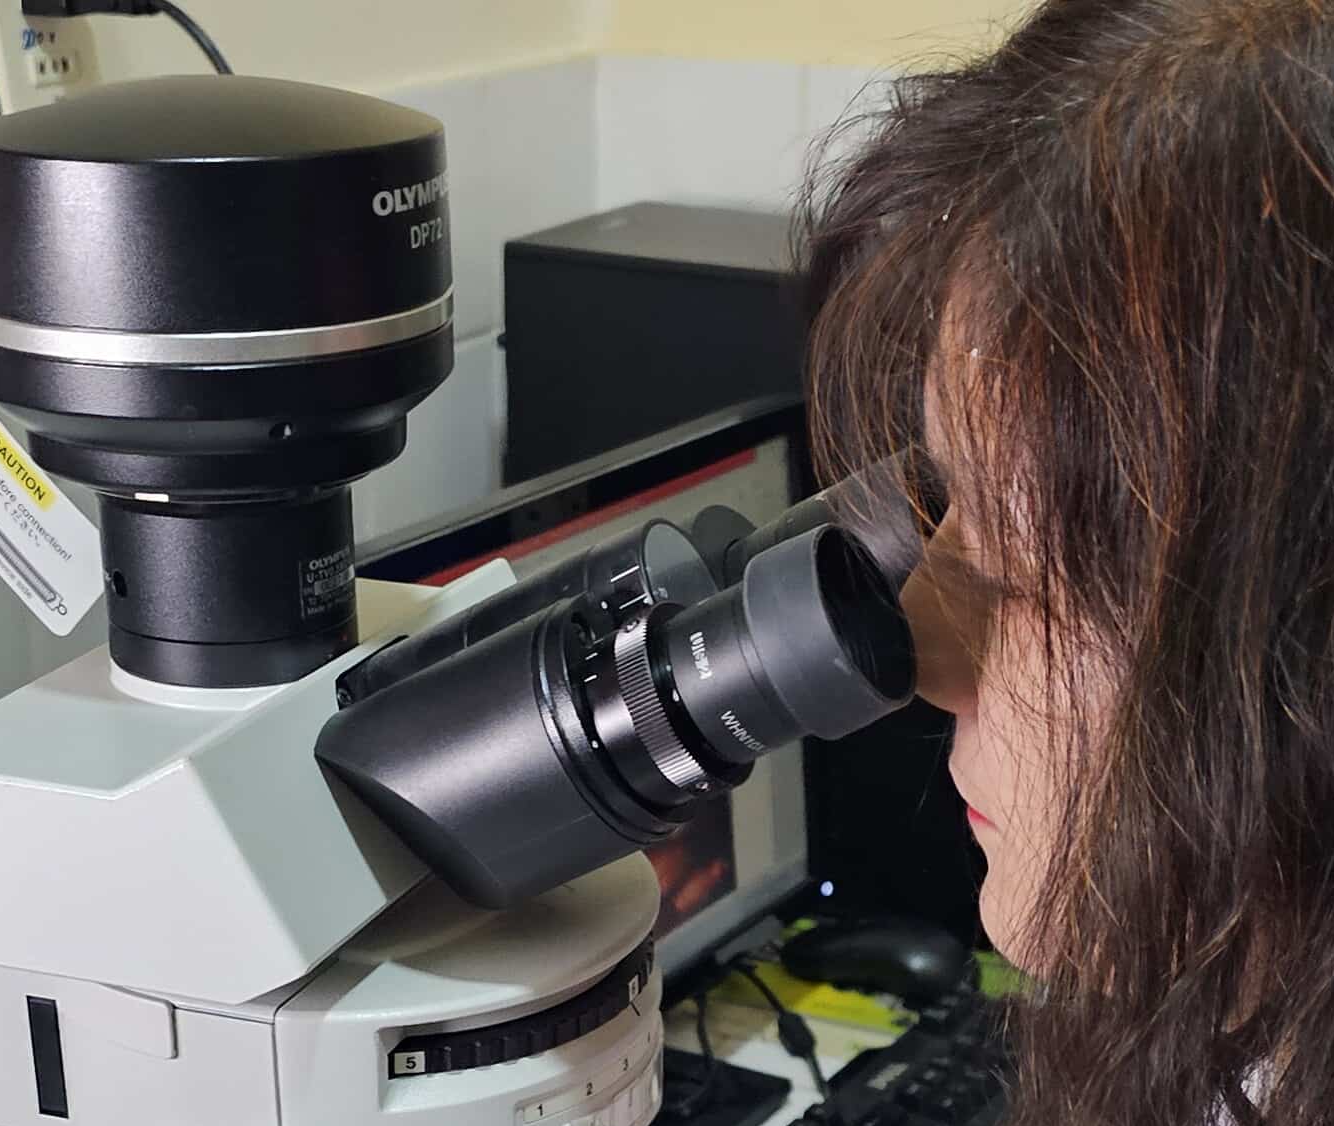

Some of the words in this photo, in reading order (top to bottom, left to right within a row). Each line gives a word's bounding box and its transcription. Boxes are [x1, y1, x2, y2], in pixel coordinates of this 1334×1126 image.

[410, 217, 443, 249] DP72
[16, 503, 73, 562] connection!
[405, 1055, 417, 1070] 5
[586, 1082, 595, 1096] 2
[537, 1104, 544, 1117] 1
